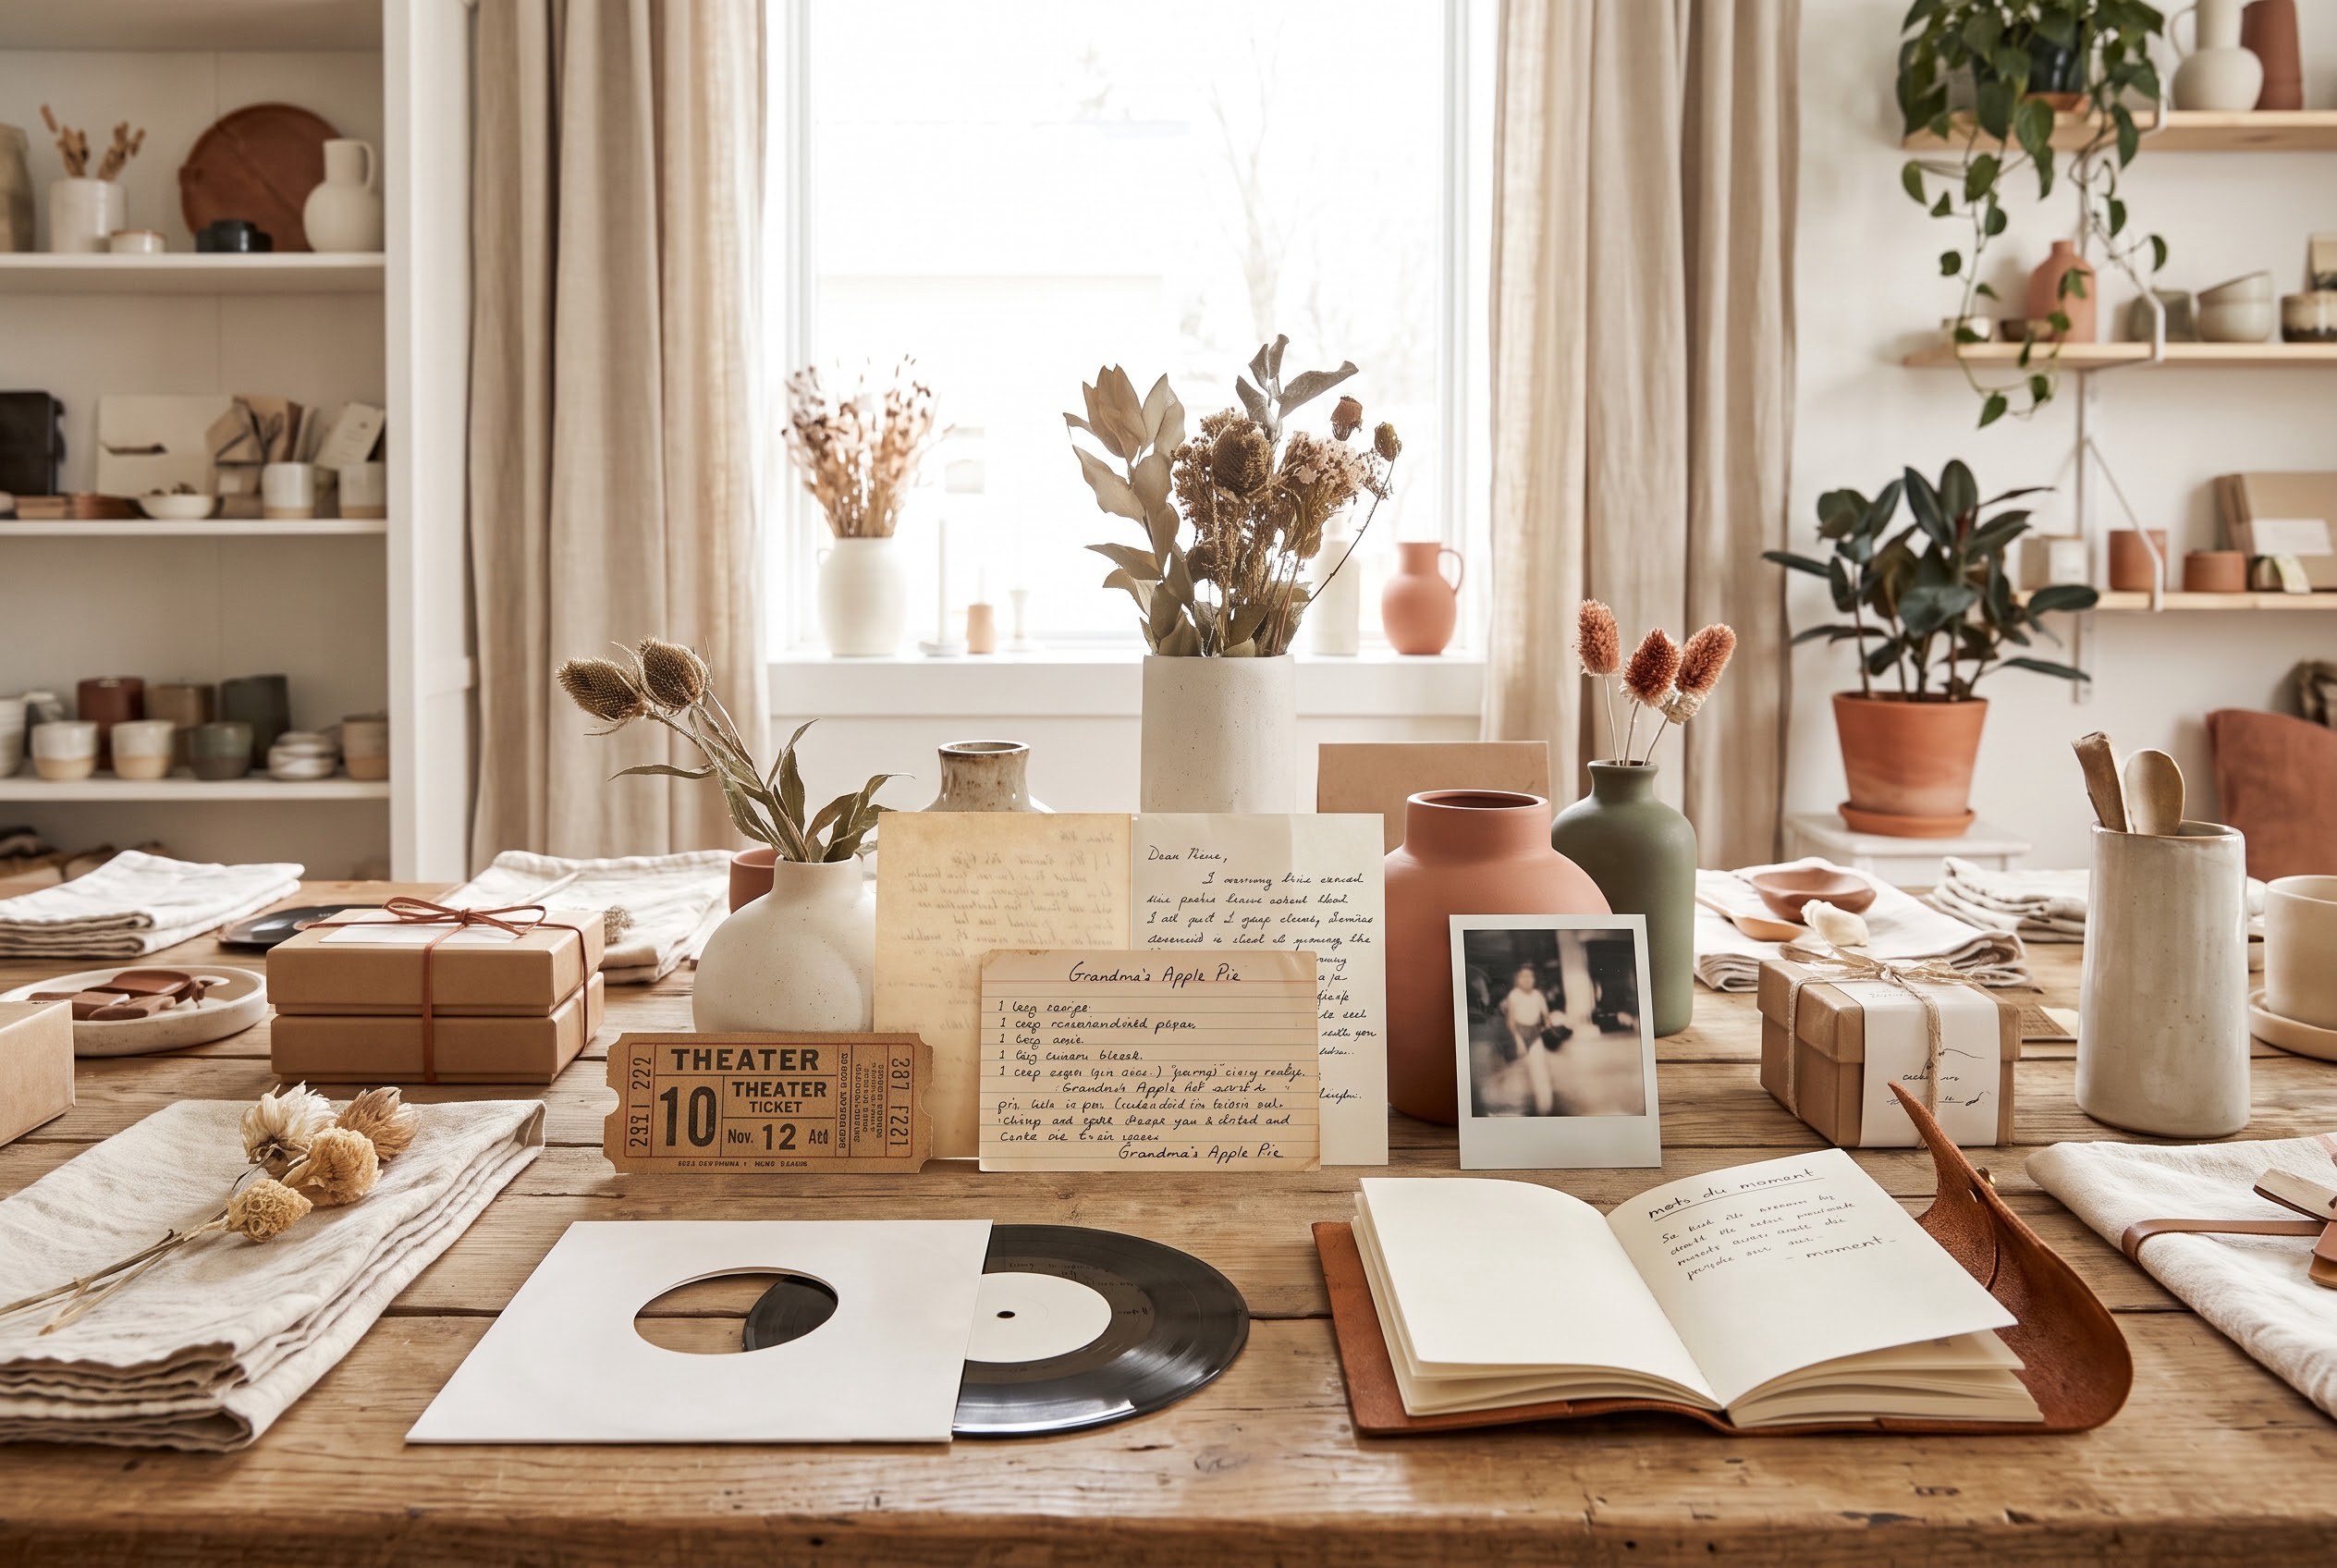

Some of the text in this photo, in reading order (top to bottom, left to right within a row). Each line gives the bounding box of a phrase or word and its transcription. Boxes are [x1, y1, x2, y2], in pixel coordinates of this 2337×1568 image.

[1069, 961, 1242, 989] Grandma's Apple Pie
[998, 999, 1004, 1011] 1
[1000, 1017, 1006, 1028] 1
[999, 1033, 1005, 1044] 1
[670, 1047, 821, 1072] THEATER
[999, 1049, 1005, 1060] 1
[999, 1065, 1006, 1076] 1
[731, 1081, 827, 1097] THEATER
[1136, 1081, 1176, 1099] Apple
[749, 1100, 803, 1113] TICKET
[659, 1084, 718, 1147] 10
[1266, 1113, 1291, 1125] and
[728, 1128, 753, 1145] Nov.
[762, 1122, 797, 1150] 12
[1118, 1142, 1285, 1164] Grandma's Apple Pie
[1703, 1187, 1728, 1198] du
[1805, 1235, 1884, 1258] moment
